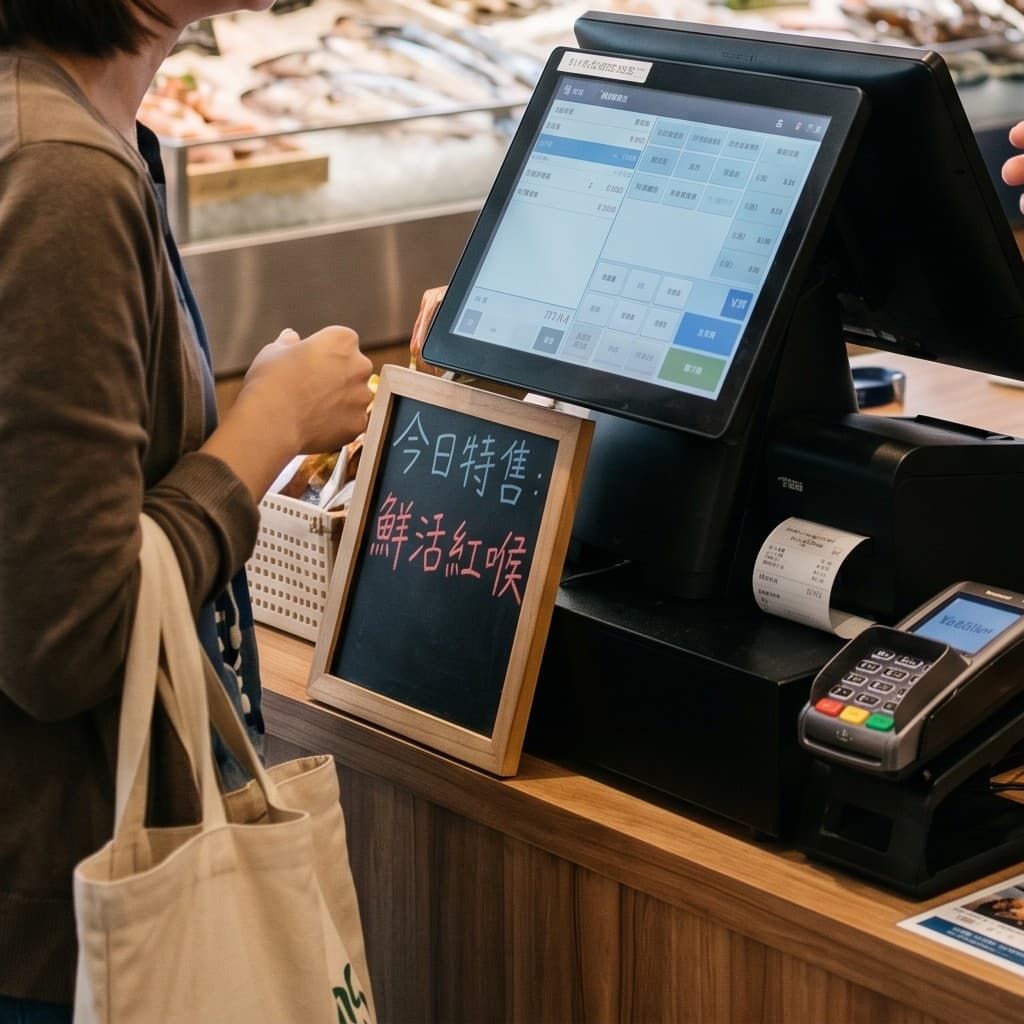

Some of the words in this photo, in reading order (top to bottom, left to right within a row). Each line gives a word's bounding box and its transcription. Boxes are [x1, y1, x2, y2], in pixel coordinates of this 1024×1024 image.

[393, 411, 542, 505] 今日特售:
[370, 491, 526, 605] 鮮活紅喉
